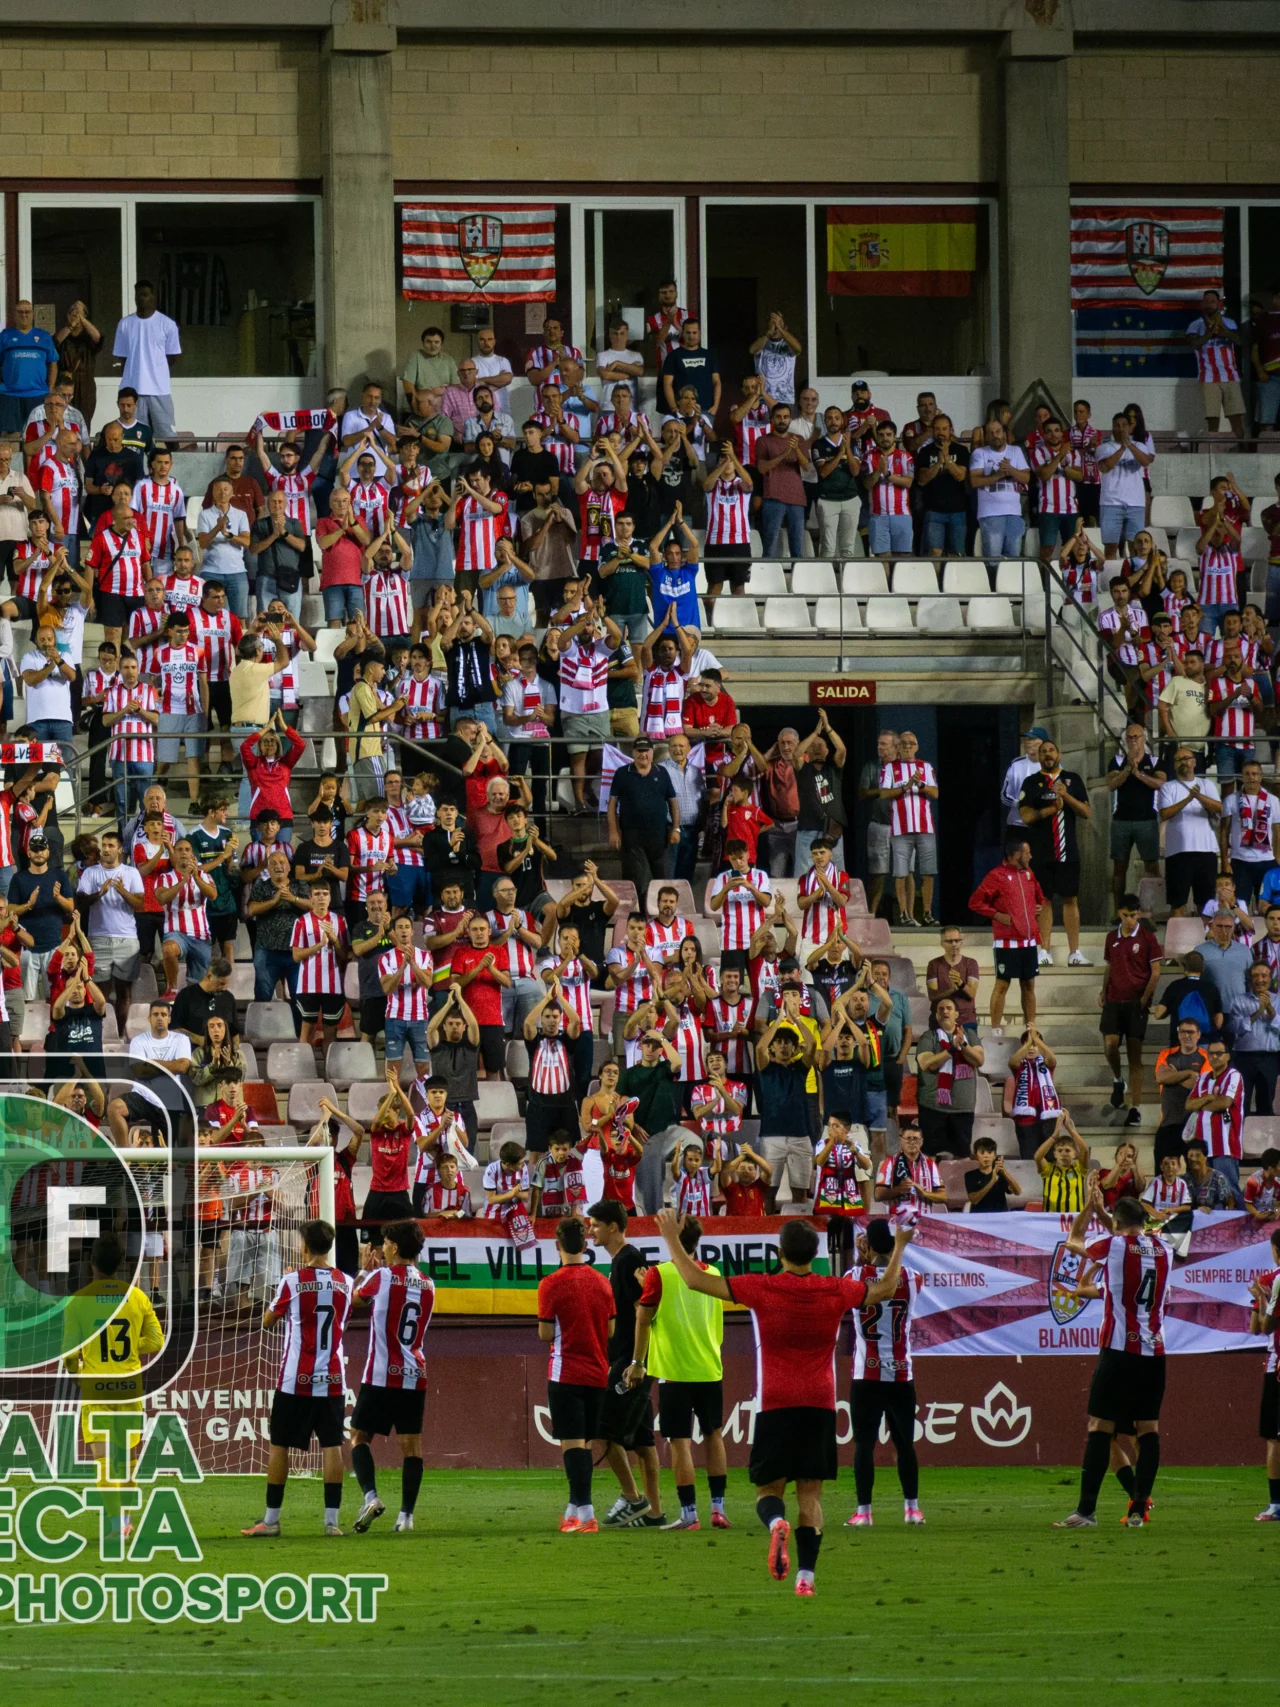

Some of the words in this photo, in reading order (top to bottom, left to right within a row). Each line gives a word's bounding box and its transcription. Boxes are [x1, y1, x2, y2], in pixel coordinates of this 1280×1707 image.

[816, 686, 870, 698] SALIDA
[427, 1246, 471, 1280] EL
[933, 1272, 988, 1288] ESTEMOS,
[1184, 1269, 1233, 1284] SIEMPRE
[1235, 1269, 1274, 1283] BLANQU
[295, 1281, 323, 1293] DAVID
[1134, 1268, 1157, 1312] 4
[313, 1304, 337, 1351] 7
[397, 1301, 423, 1346] 6
[860, 1298, 909, 1342] 27
[93, 1317, 131, 1363] 13
[1038, 1327, 1100, 1348] BLANQU
